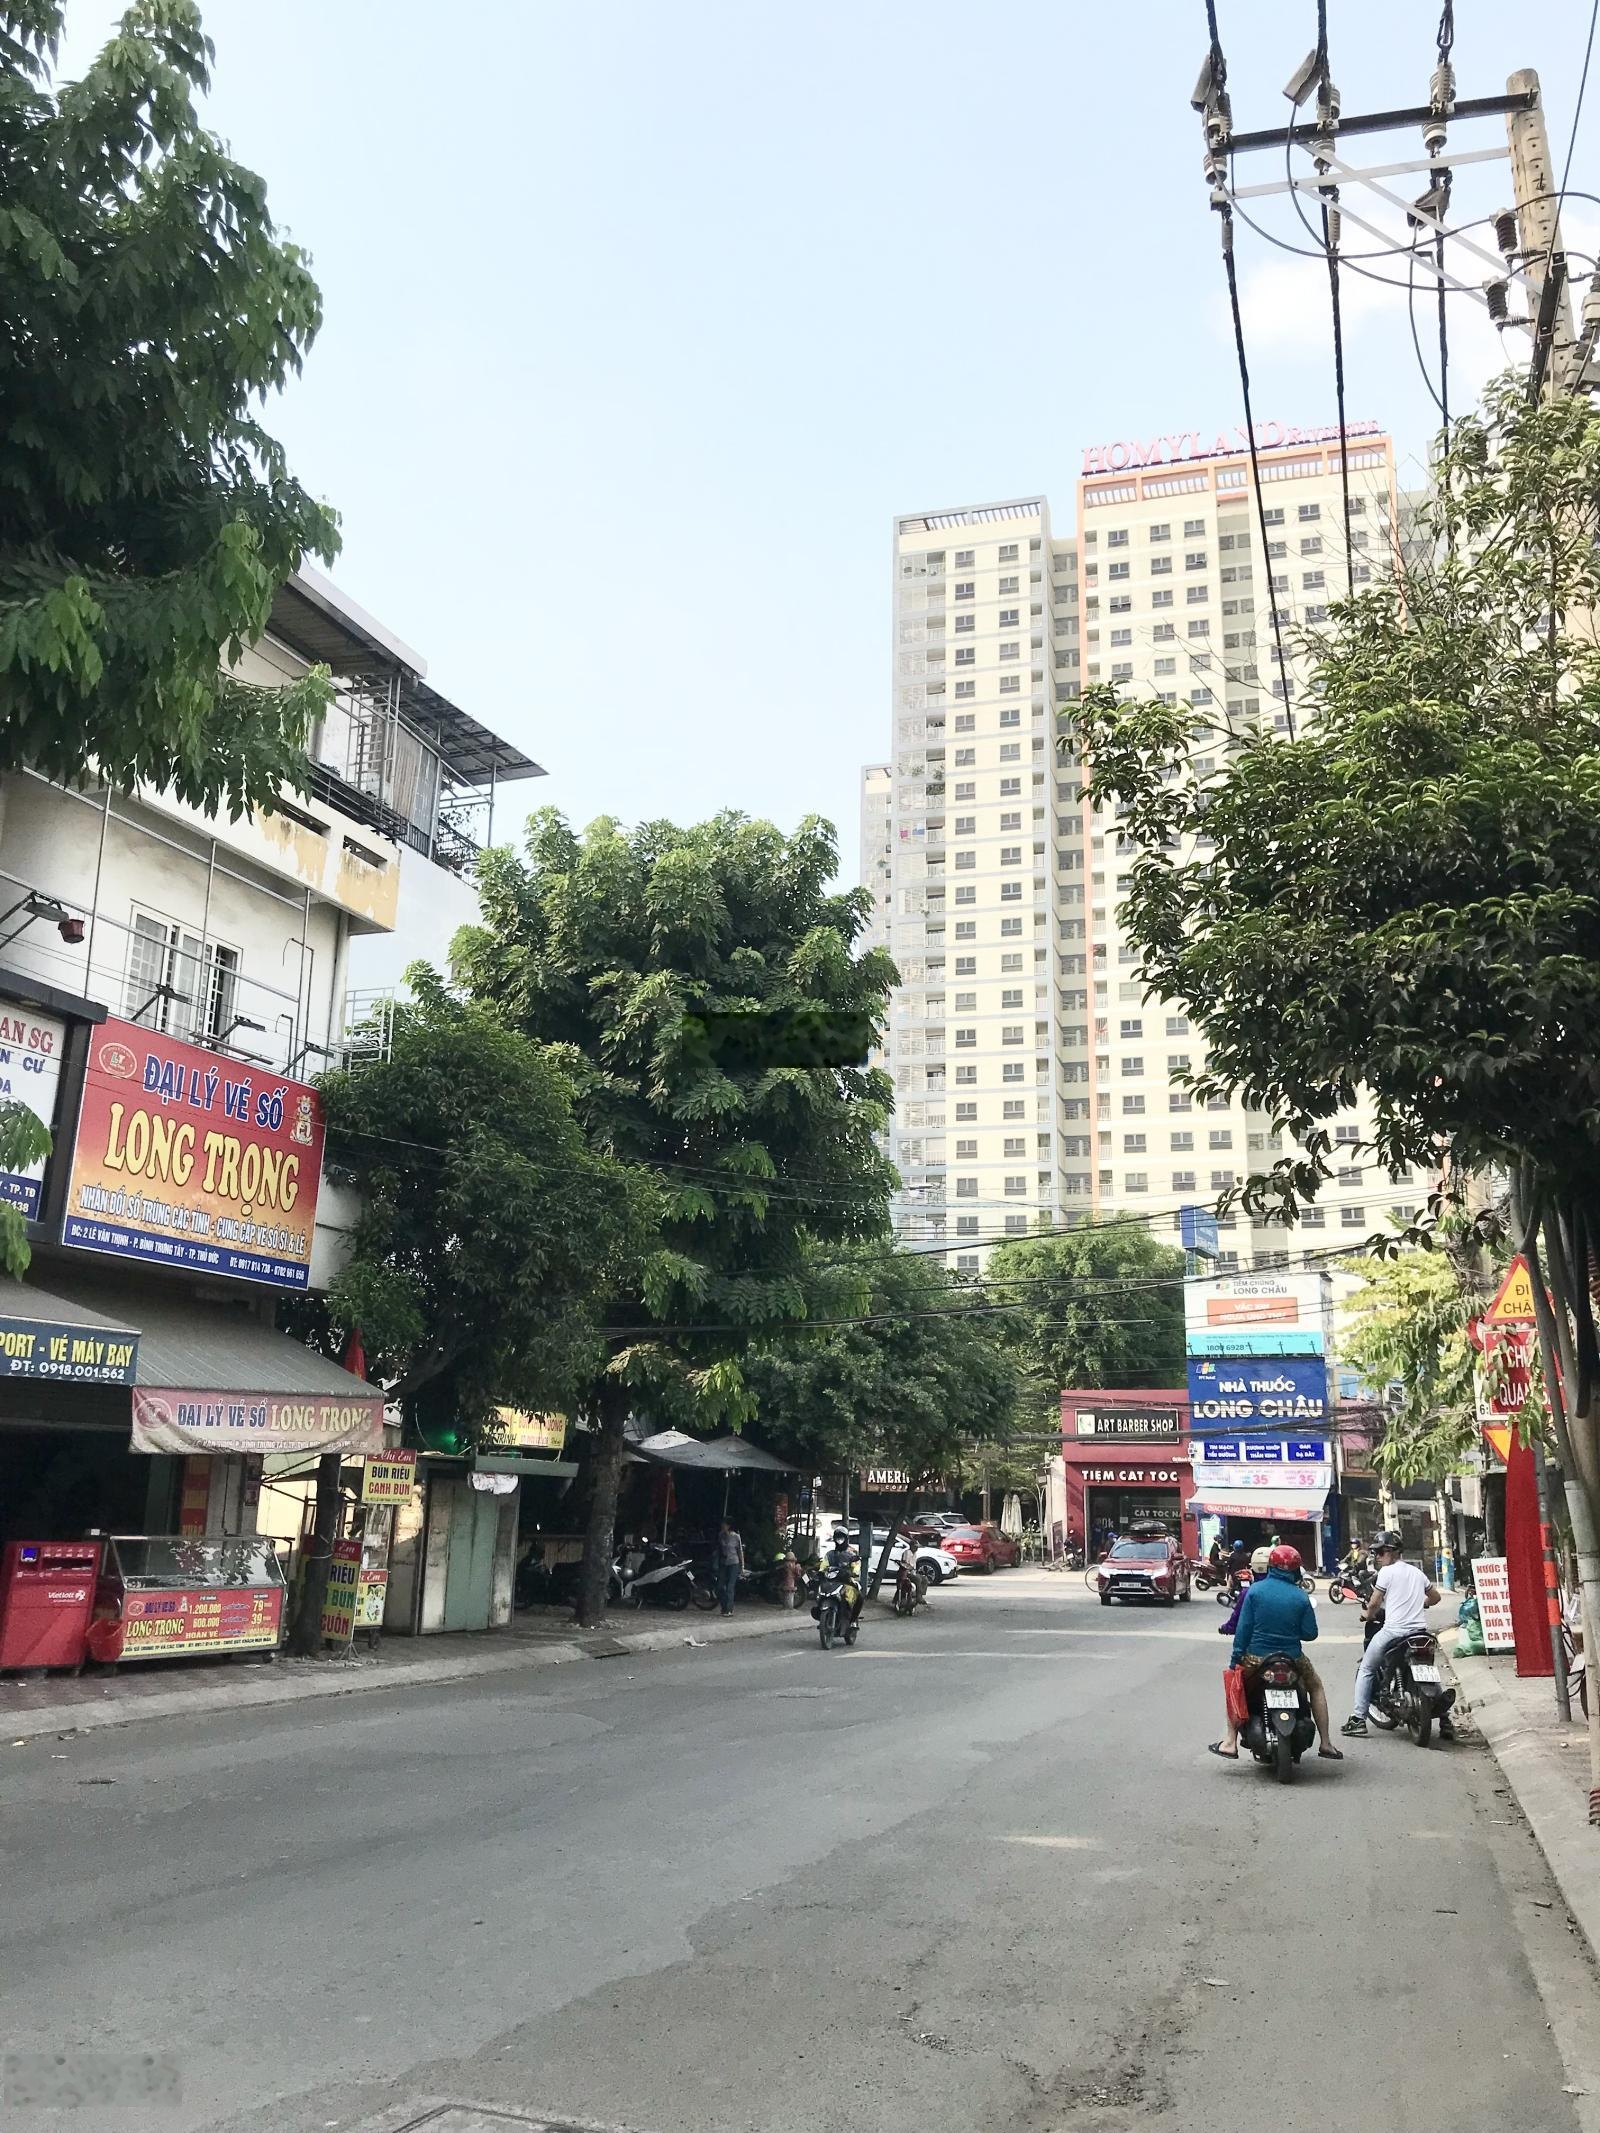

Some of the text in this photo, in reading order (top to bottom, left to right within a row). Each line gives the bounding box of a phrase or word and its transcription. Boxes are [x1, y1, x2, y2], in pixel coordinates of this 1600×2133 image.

[1081, 420, 1285, 474] HOMYLAND
[28, 1027, 54, 1054] SG
[23, 1056, 46, 1074] CƯ
[143, 1053, 289, 1132] ĐẠI LÝ VÉ SỐ
[103, 1102, 299, 1217] LONG TRỌNG
[80, 1183, 109, 1216] NHẬN
[127, 1190, 142, 1220] SỐ
[141, 1197, 171, 1226] TRÚNG
[171, 1203, 190, 1229] CÁC
[216, 1216, 240, 1241] CUNG
[240, 1216, 256, 1245] CẤP
[256, 1221, 268, 1247] VÉ
[267, 1223, 280, 1249] SỐ
[288, 1232, 295, 1253] &
[82, 1226, 88, 1239] 2
[88, 1226, 97, 1240] LÊ
[1233, 1284, 1288, 1295] LONG CHÂU
[1515, 1284, 1529, 1296] ĐI
[1503, 1300, 1533, 1315] CHẬ
[50, 1334, 69, 1361] VÉ
[72, 1337, 104, 1364] MÁY
[106, 1343, 134, 1368] BAY
[39, 1361, 125, 1380] 0918.001.562
[1219, 1374, 1296, 1393] NHÀ THUỐC
[1193, 1394, 1324, 1418] LONG CHÂU
[270, 1404, 315, 1431] LONG
[1097, 1418, 1174, 1432] ART BARBER SHOP
[371, 1464, 410, 1480] BÚN RIÊU
[1119, 1470, 1145, 1481] CAT
[1149, 1471, 1178, 1481] TOC
[1252, 1474, 1269, 1485] 35
[1298, 1474, 1316, 1485] 35
[368, 1481, 410, 1495] CANH BÚN
[1134, 1509, 1150, 1517] CAT
[330, 1563, 355, 1585] RIÊU
[1478, 1578, 1500, 1587] SINH
[253, 1600, 264, 1612] 79
[250, 1613, 263, 1625] 39
[125, 1619, 153, 1638] LONG
